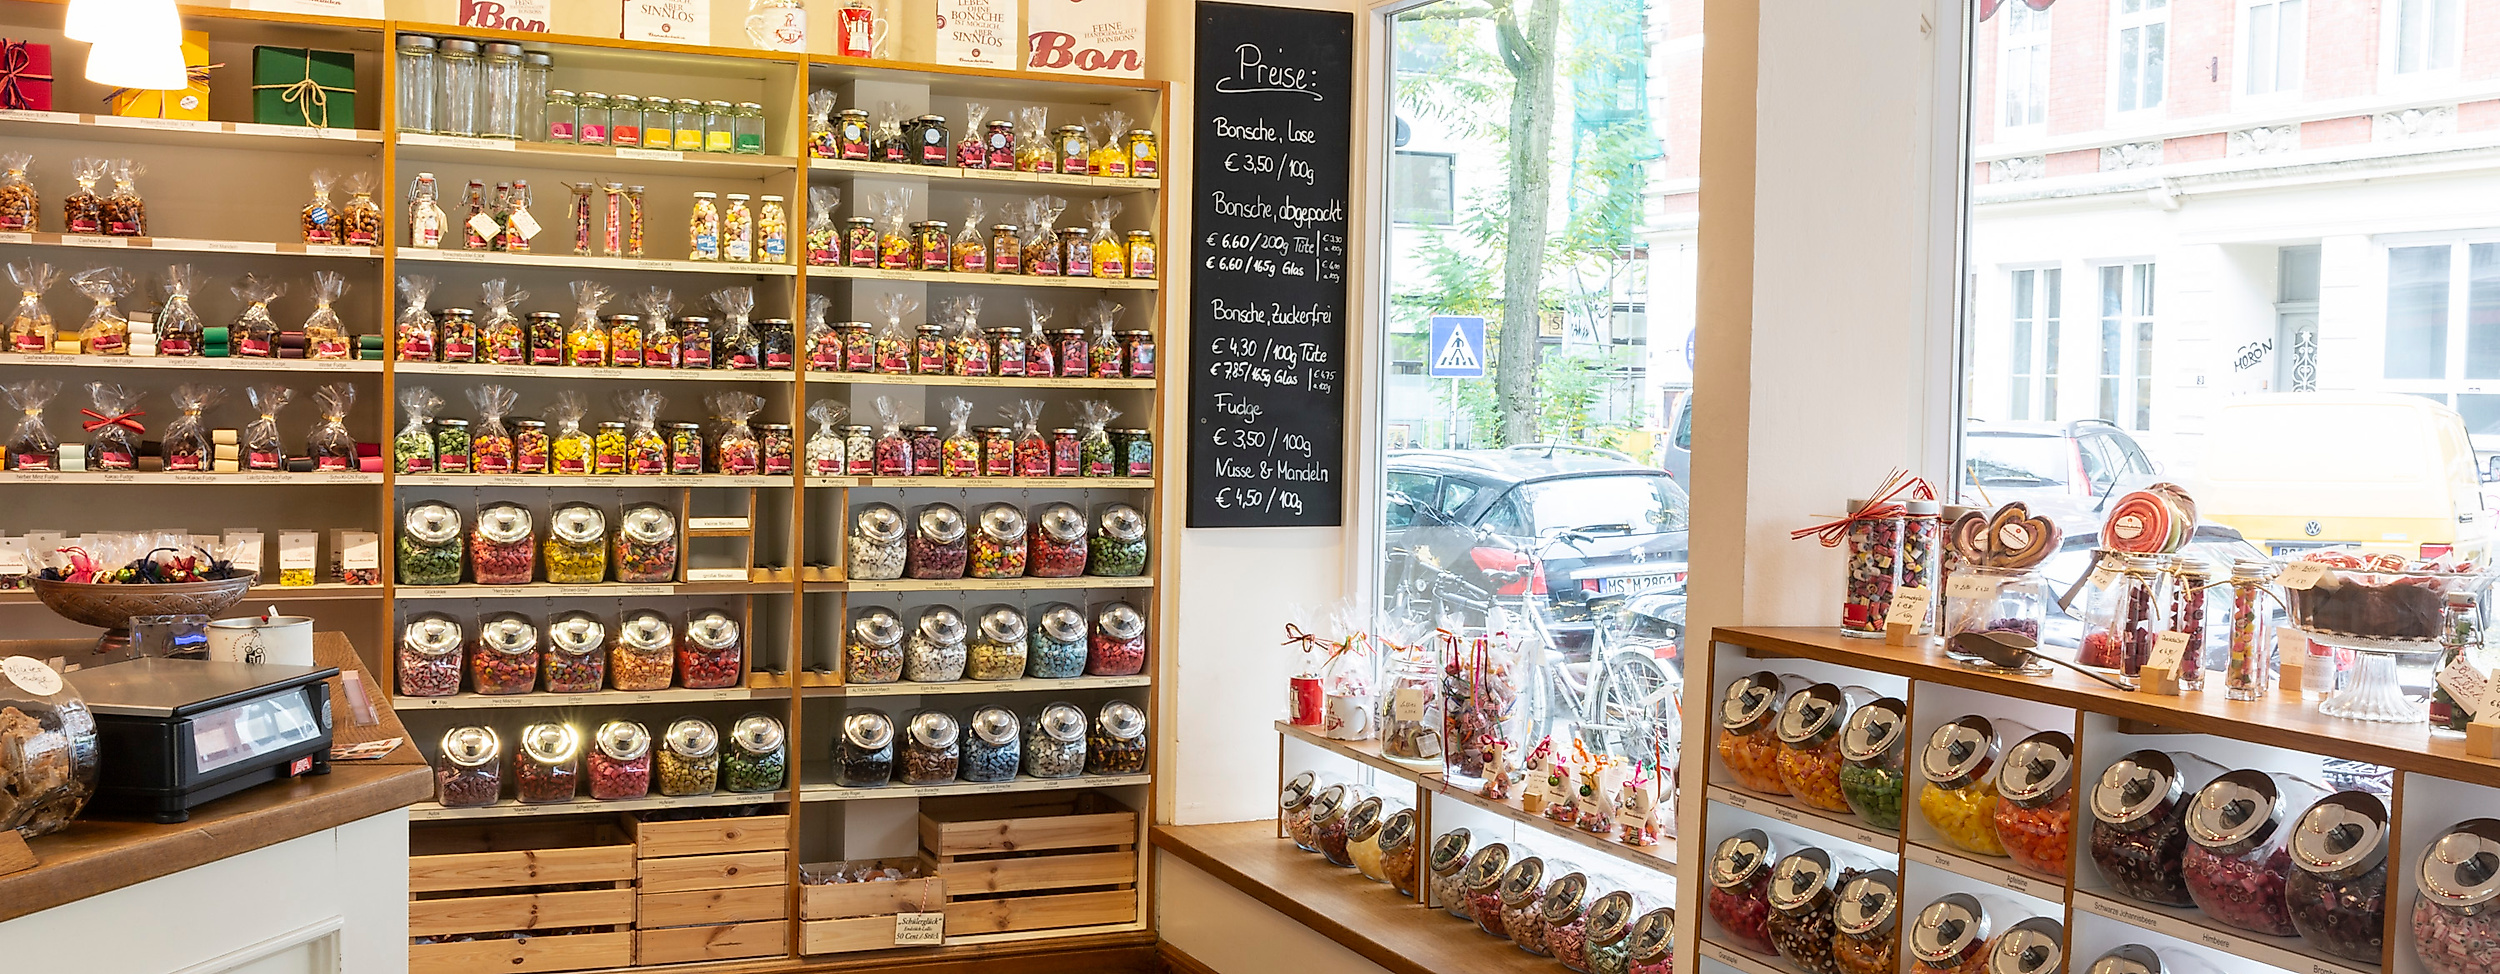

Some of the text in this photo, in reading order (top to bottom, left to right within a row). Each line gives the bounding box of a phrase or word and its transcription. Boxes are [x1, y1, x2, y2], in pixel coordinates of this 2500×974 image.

[640, 4, 694, 23] SINNLOS
[951, 10, 1004, 23] BONSCHE
[1092, 22, 1122, 33] FEINE
[952, 31, 1003, 48] SINNLOS
[1096, 34, 1135, 44] BONBONS
[1028, 31, 1142, 71] Bon
[1235, 44, 1318, 90] Preise:
[1212, 116, 1283, 144] Bonsche,
[1224, 153, 1240, 173] €
[1243, 155, 1274, 175] 3,50
[1206, 232, 1219, 247] €
[1293, 235, 1315, 254] Tüte
[1206, 256, 1216, 270] €
[1282, 261, 1305, 277] Glas
[1211, 338, 1226, 355] €
[1229, 338, 1257, 358] 4,30
[1298, 342, 1328, 363] Tüte
[1210, 363, 1222, 377] €
[1274, 369, 1299, 386] Glas
[1214, 392, 1263, 424] Fudge
[1213, 428, 1228, 447] €
[1232, 430, 1266, 449] 3,50
[1215, 457, 1329, 484] Nüsse & Mandeln
[1215, 487, 1231, 509] €
[1235, 488, 1262, 510] 4,50
[1935, 856, 1950, 867] Zitrone
[2094, 902, 2157, 927] Schwarze Johannisbeere
[2202, 932, 2230, 948] Himbeere
